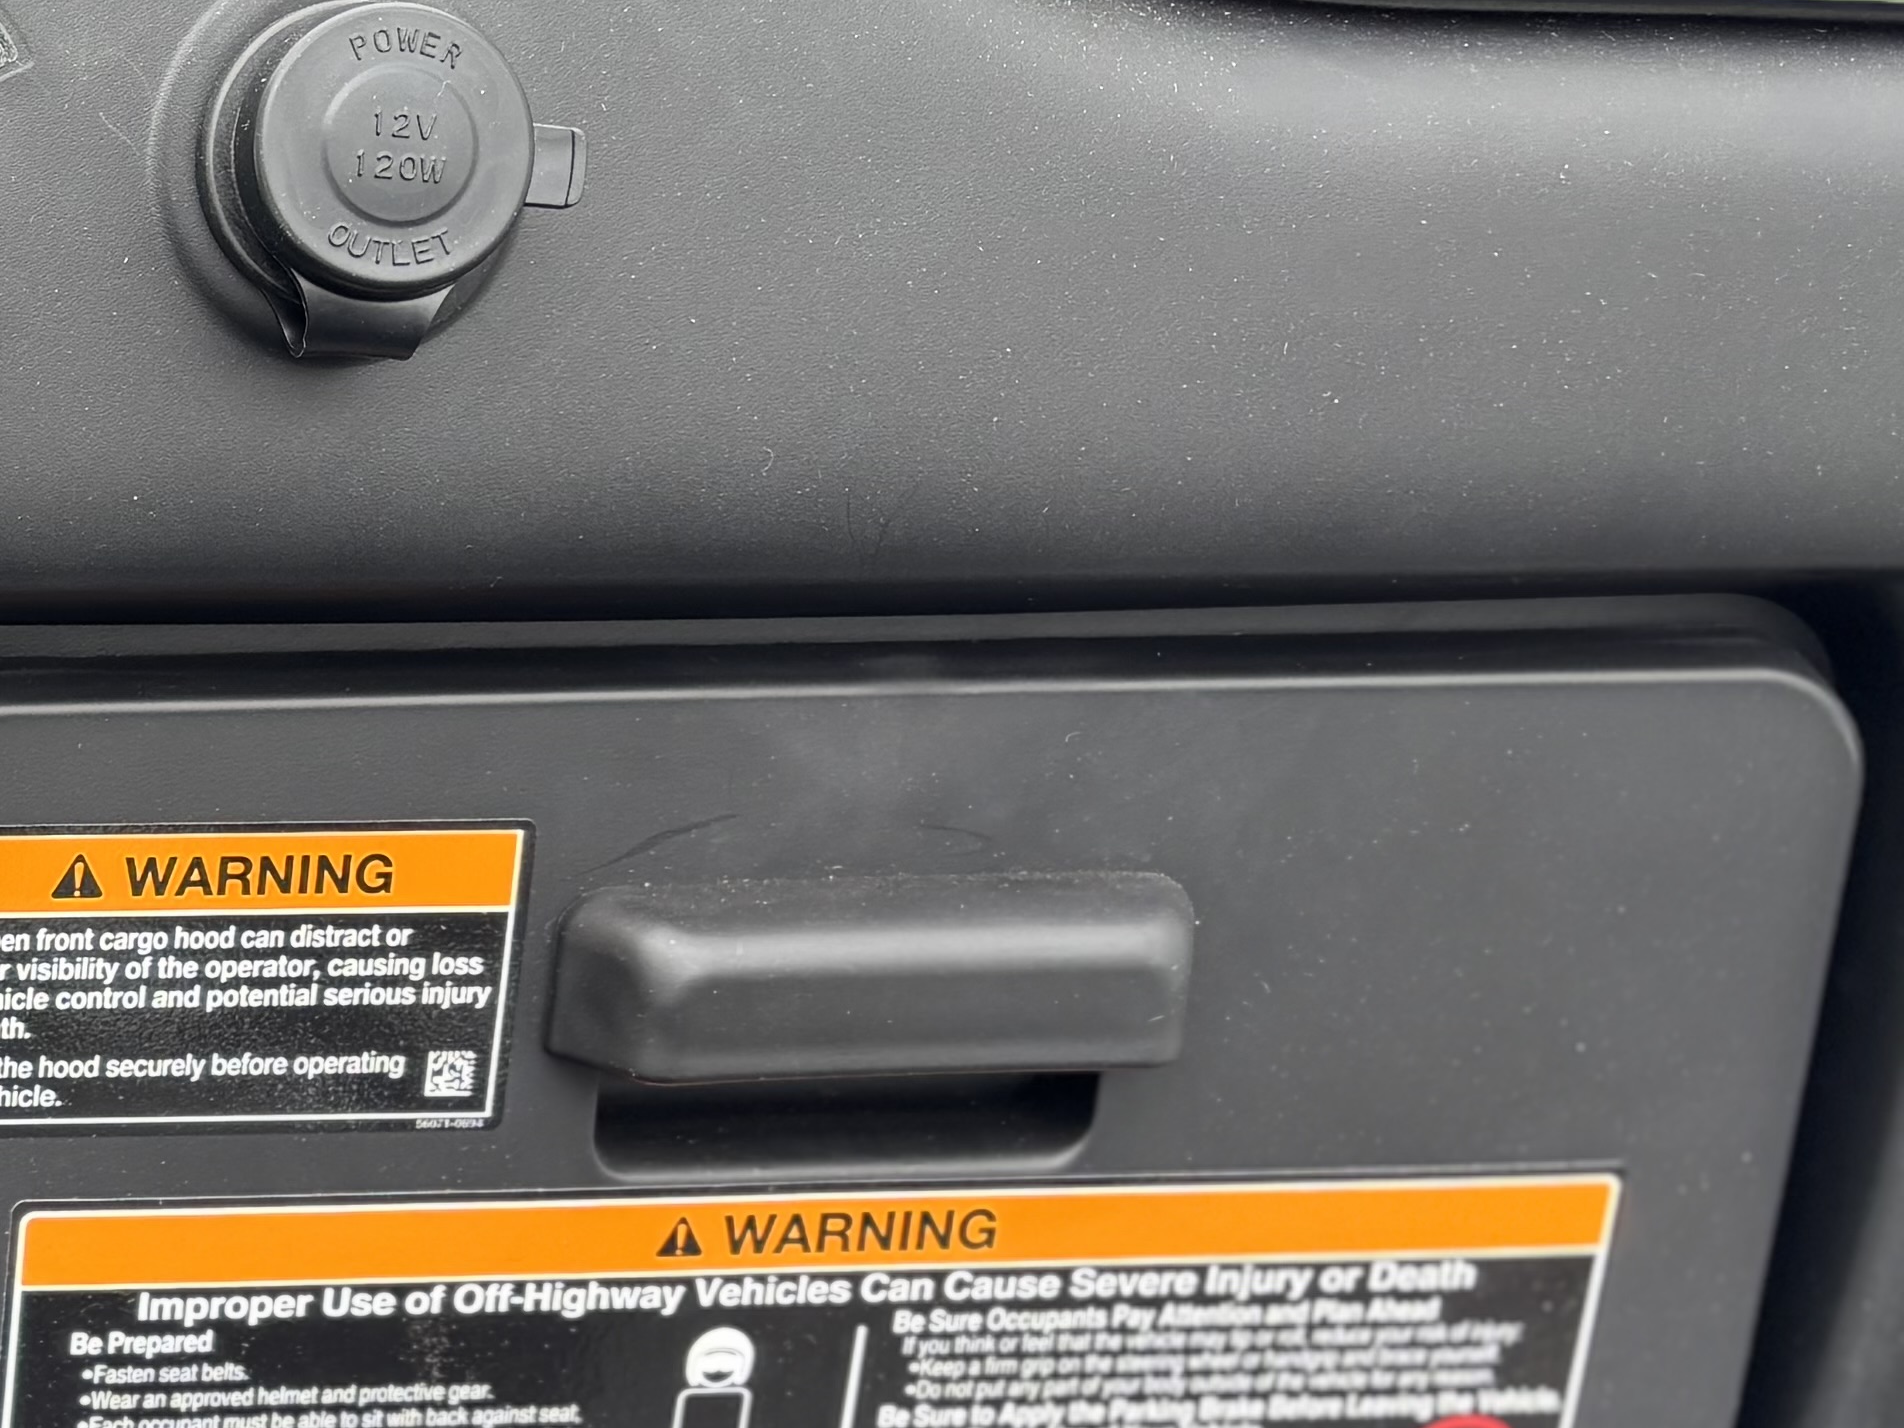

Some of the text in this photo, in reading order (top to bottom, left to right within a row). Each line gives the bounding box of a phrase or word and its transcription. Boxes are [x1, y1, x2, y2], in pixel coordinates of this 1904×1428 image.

[348, 26, 464, 70] POWER
[373, 108, 437, 141] 12V
[354, 149, 447, 185] 120W
[326, 222, 455, 267] OUTLET
[125, 853, 392, 896] WARNING
[35, 927, 95, 951] front
[98, 931, 168, 955] cargo
[173, 924, 236, 949] hood
[240, 929, 284, 948] can
[289, 923, 382, 948] distract
[385, 927, 413, 946] or
[16, 956, 119, 984] visibility
[124, 955, 153, 979] of
[157, 955, 199, 979] the
[204, 954, 320, 983] operator,
[327, 952, 426, 981] causing
[431, 951, 484, 975] loss
[54, 984, 147, 1010] control
[150, 984, 201, 1008] and
[205, 982, 318, 1012] potential
[322, 981, 416, 1006] serious
[421, 980, 492, 1009] injury
[37, 1054, 100, 1078] hood
[104, 1052, 206, 1082] securely
[210, 1051, 288, 1076] before
[292, 1050, 406, 1079] operating
[724, 1208, 996, 1254] WARNING
[137, 1258, 1478, 1327] Improper Use of Off-Highway Vehicles Can Cause Severe Injury or Death
[892, 1311, 925, 1333] Be
[928, 1309, 983, 1333] Sure
[986, 1306, 1108, 1333] Occupants
[69, 1328, 213, 1357] Be Prepared
[91, 1361, 248, 1384] Fasten seat belts.
[90, 1390, 139, 1409] Wear
[142, 1393, 166, 1408] an
[169, 1386, 254, 1411] approved
[257, 1385, 318, 1405] helmet
[320, 1384, 357, 1404] and
[339, 1411, 358, 1428] to
[424, 1406, 468, 1426] back
